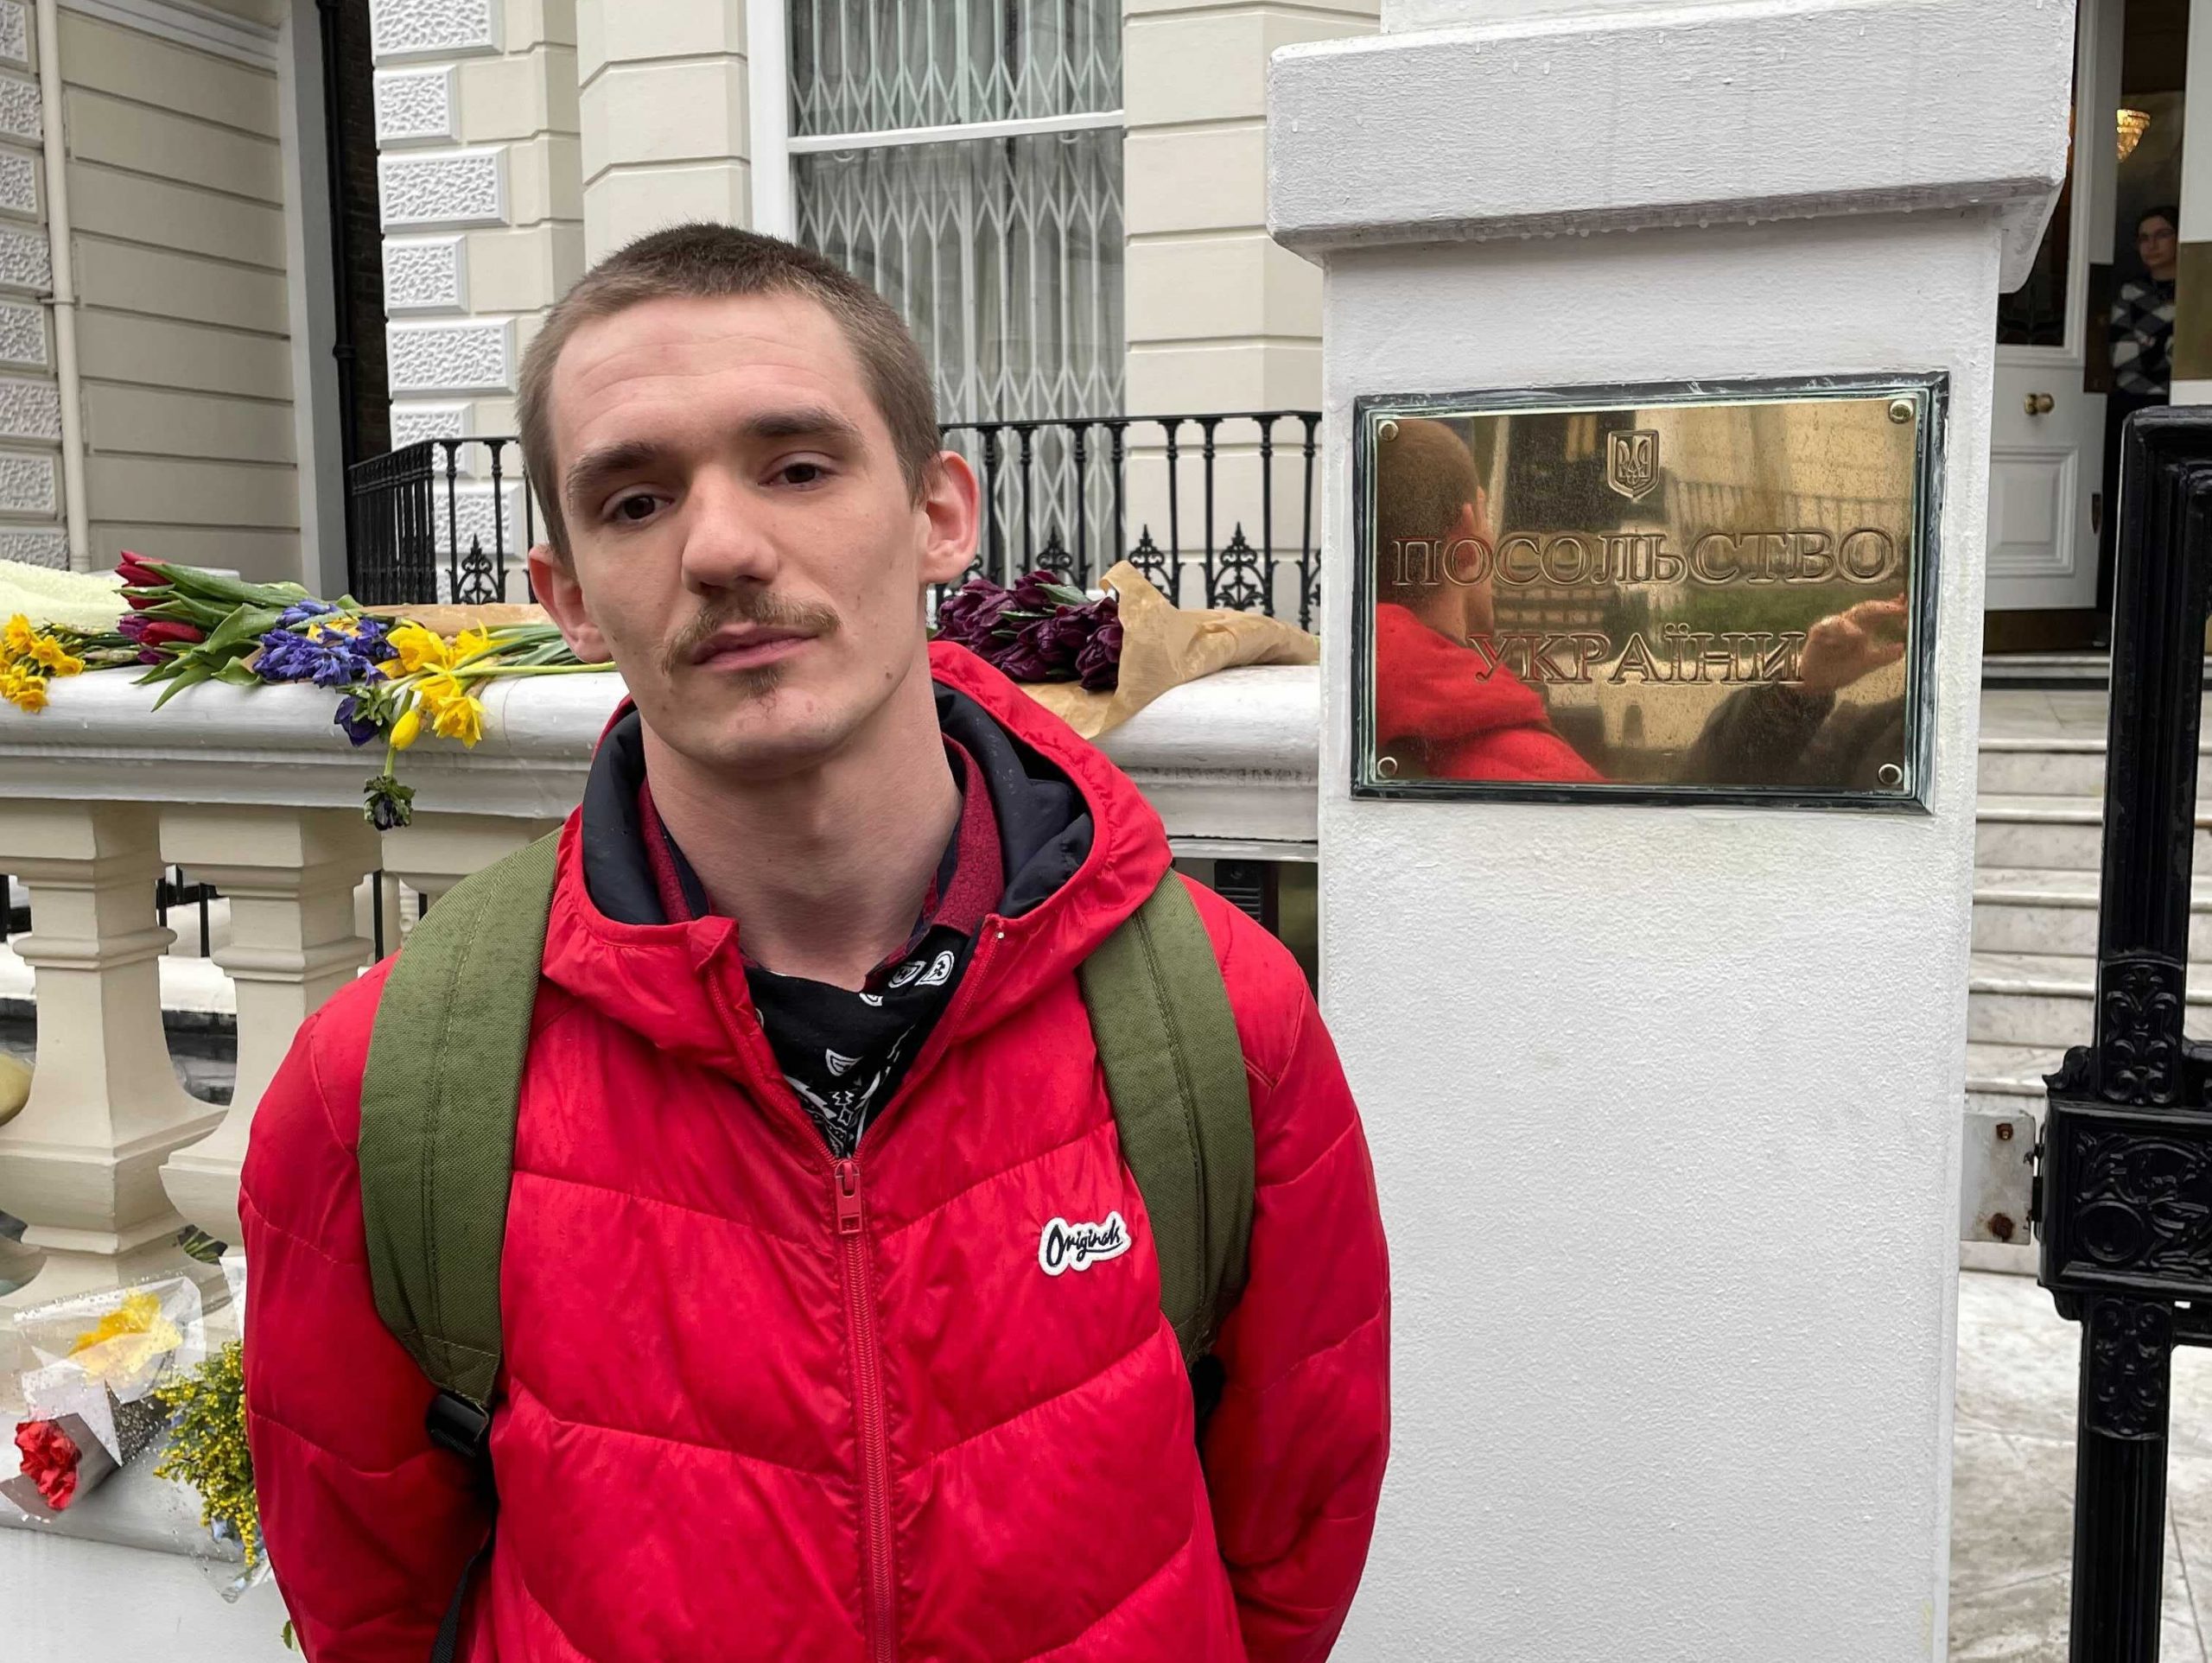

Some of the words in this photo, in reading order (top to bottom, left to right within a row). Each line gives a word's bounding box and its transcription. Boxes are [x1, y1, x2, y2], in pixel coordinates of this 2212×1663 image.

[1392, 527, 1895, 587] ПОСОЛЬСТВО
[1468, 622, 1807, 686] УКРАЇНИ
[1046, 1218, 1122, 1267] Originals
